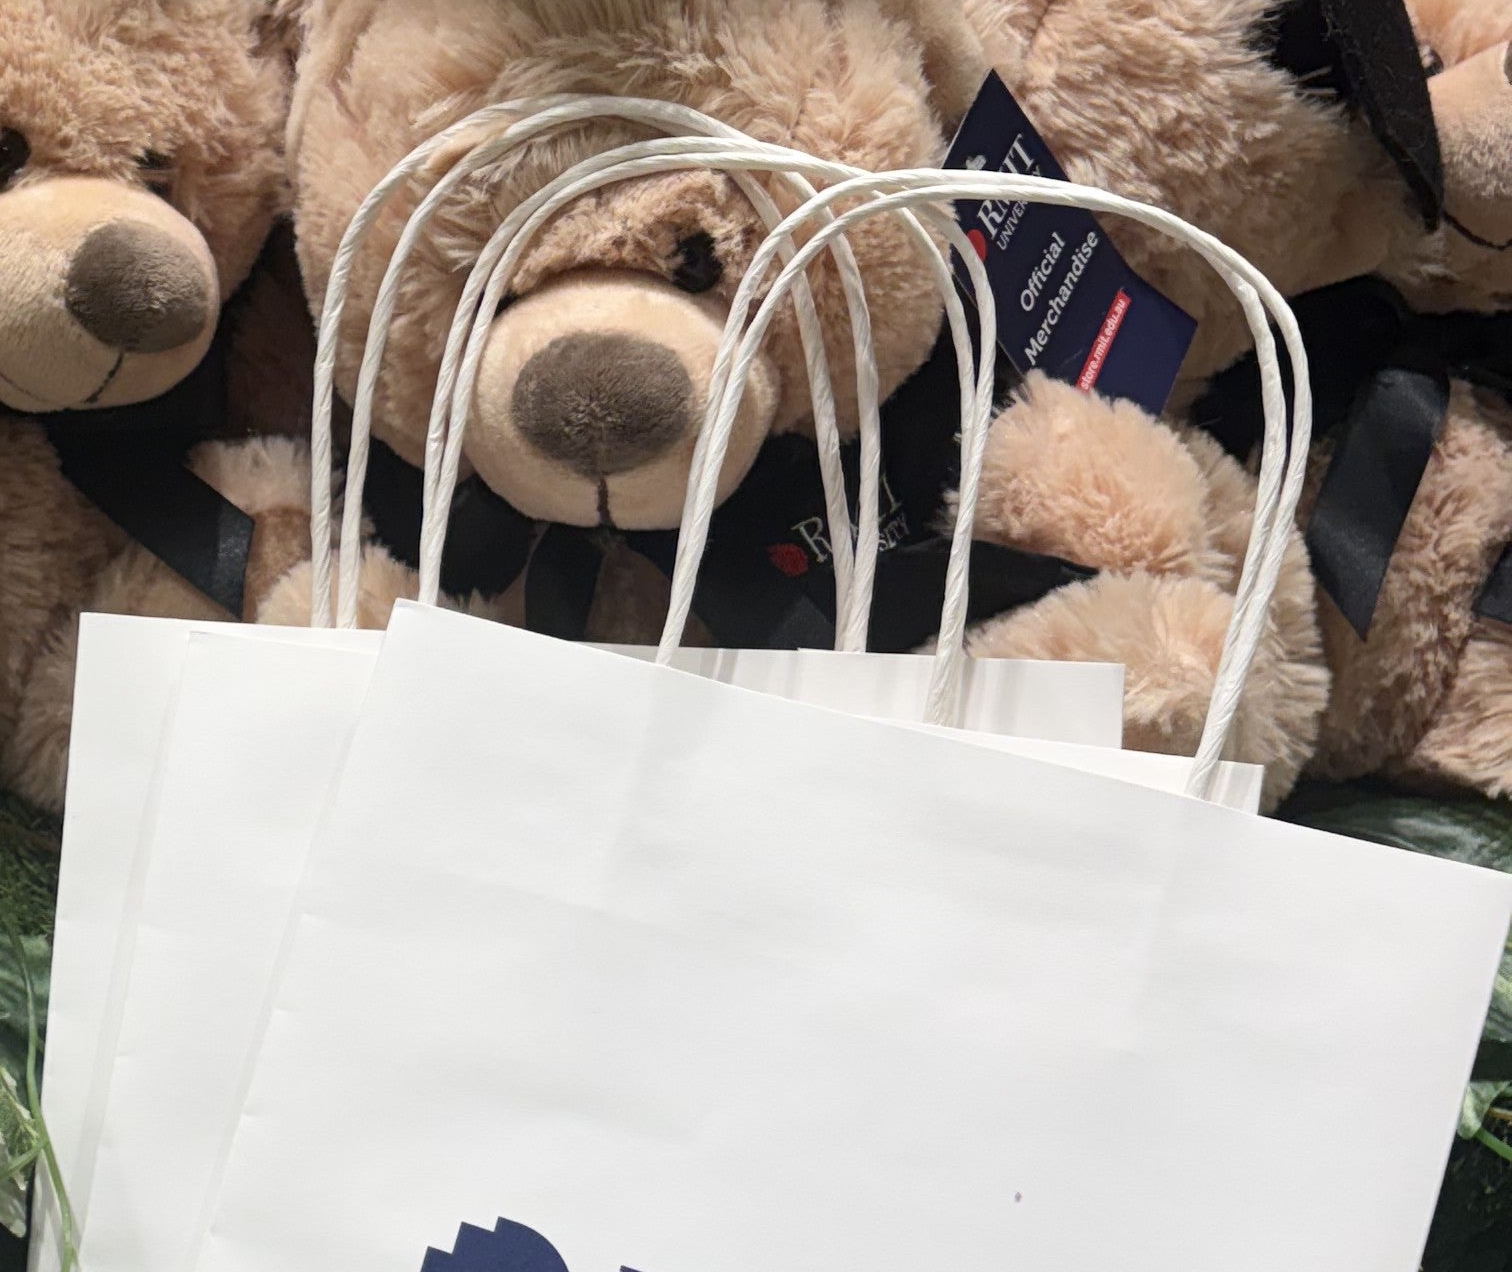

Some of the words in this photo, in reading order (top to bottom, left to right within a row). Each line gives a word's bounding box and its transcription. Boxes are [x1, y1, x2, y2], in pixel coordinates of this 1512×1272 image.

[1020, 231, 1066, 312] Official
[1024, 231, 1099, 366] Merchandise
[1081, 298, 1127, 391] store.rmit.edu.au
